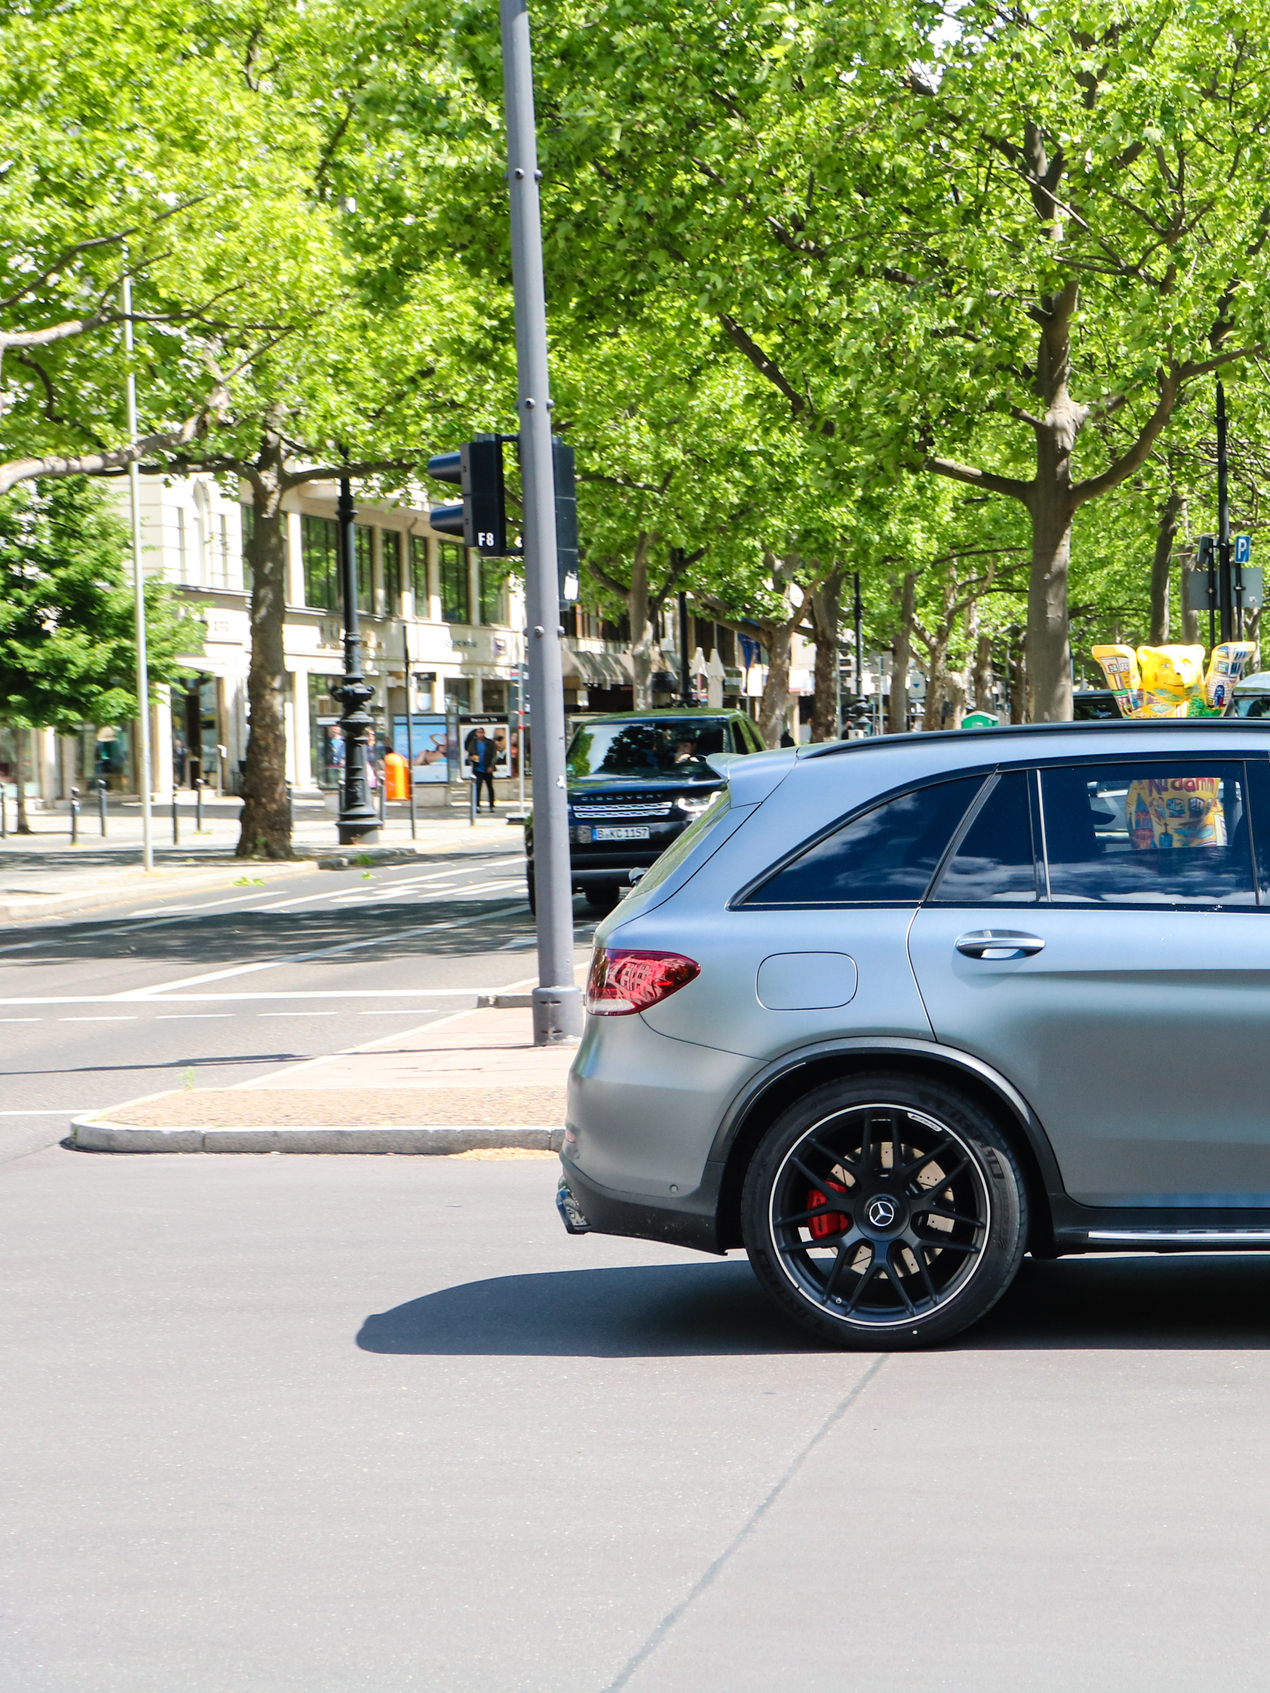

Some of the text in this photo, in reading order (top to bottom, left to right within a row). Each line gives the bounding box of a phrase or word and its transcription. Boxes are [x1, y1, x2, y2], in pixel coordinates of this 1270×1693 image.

[478, 532, 495, 547] F8
[1238, 538, 1248, 560] P
[580, 793, 664, 802] DISCOVERY
[597, 829, 605, 839] B
[625, 828, 648, 838] 1157
